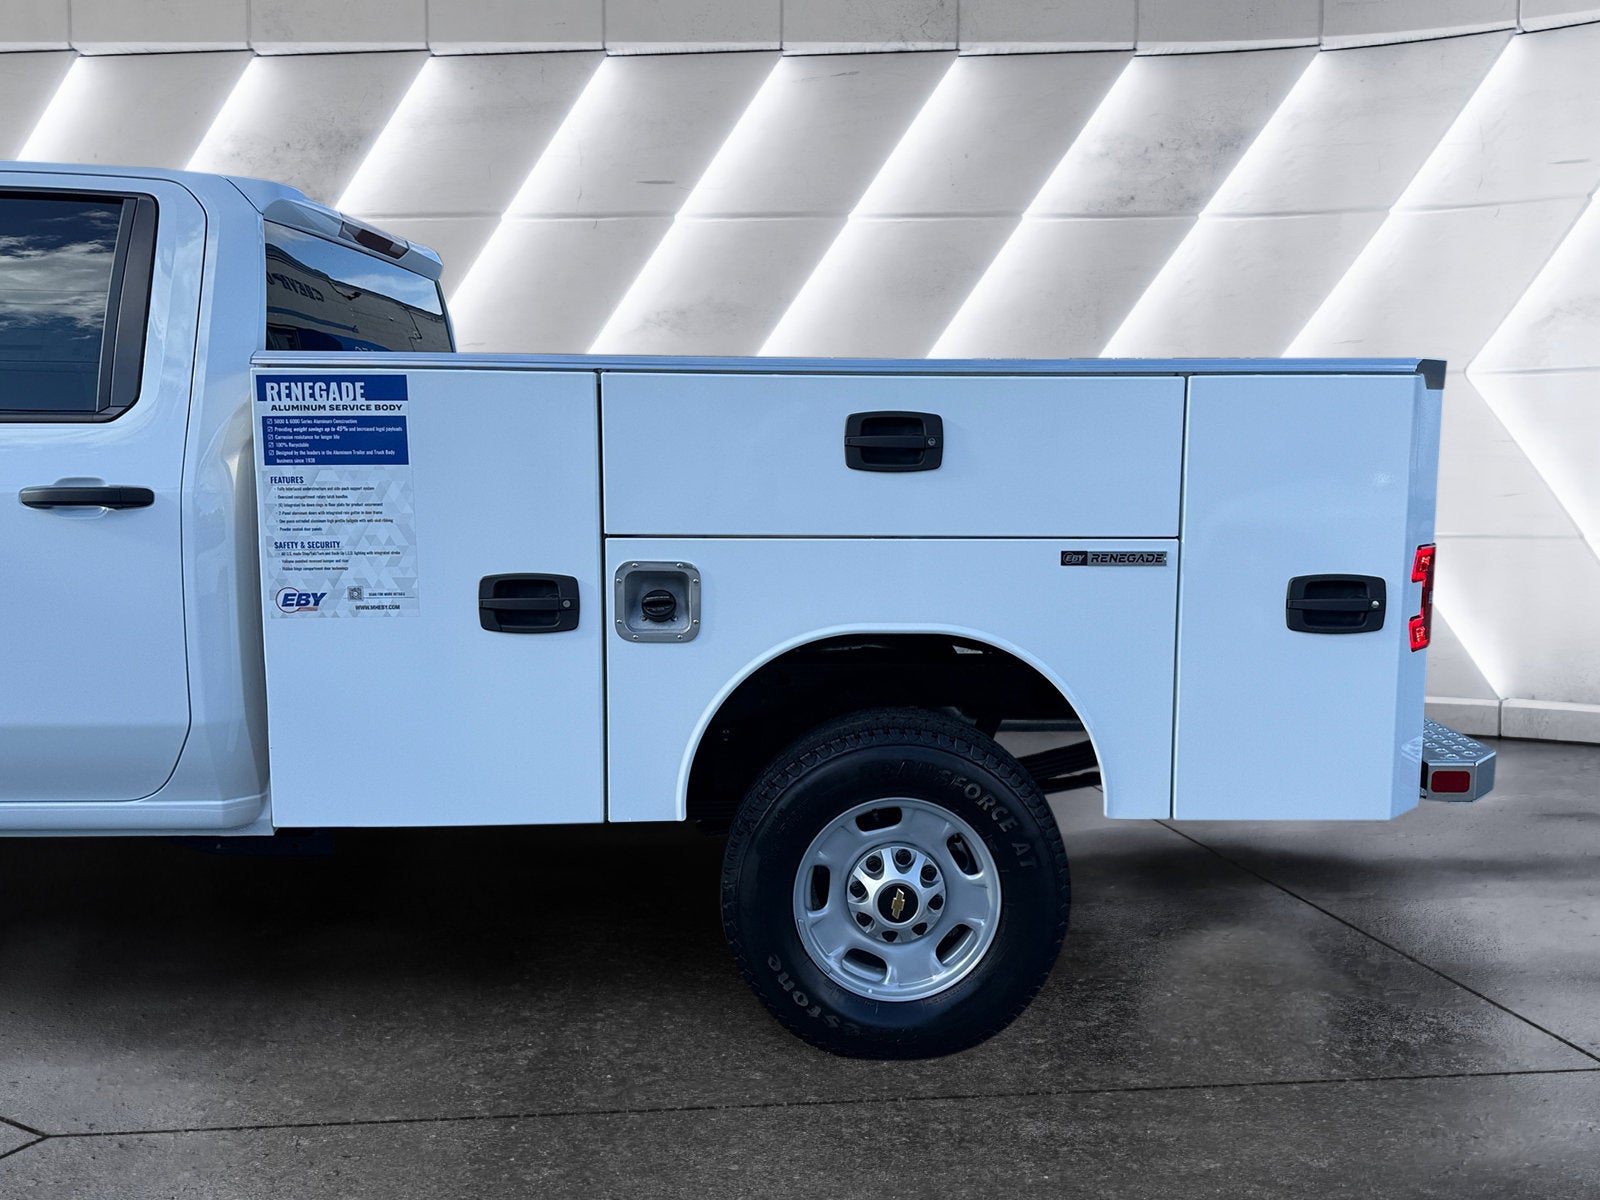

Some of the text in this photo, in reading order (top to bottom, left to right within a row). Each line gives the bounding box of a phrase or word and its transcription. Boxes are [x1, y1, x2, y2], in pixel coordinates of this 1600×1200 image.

[266, 382, 366, 401] RENEGADE
[271, 404, 403, 412] ALUMINUM SERVICE BODY
[270, 476, 304, 484] FEATURES
[274, 541, 340, 549] SAFETY & SECURITY
[1090, 553, 1164, 563] RENEGADE
[281, 593, 328, 607] EBY
